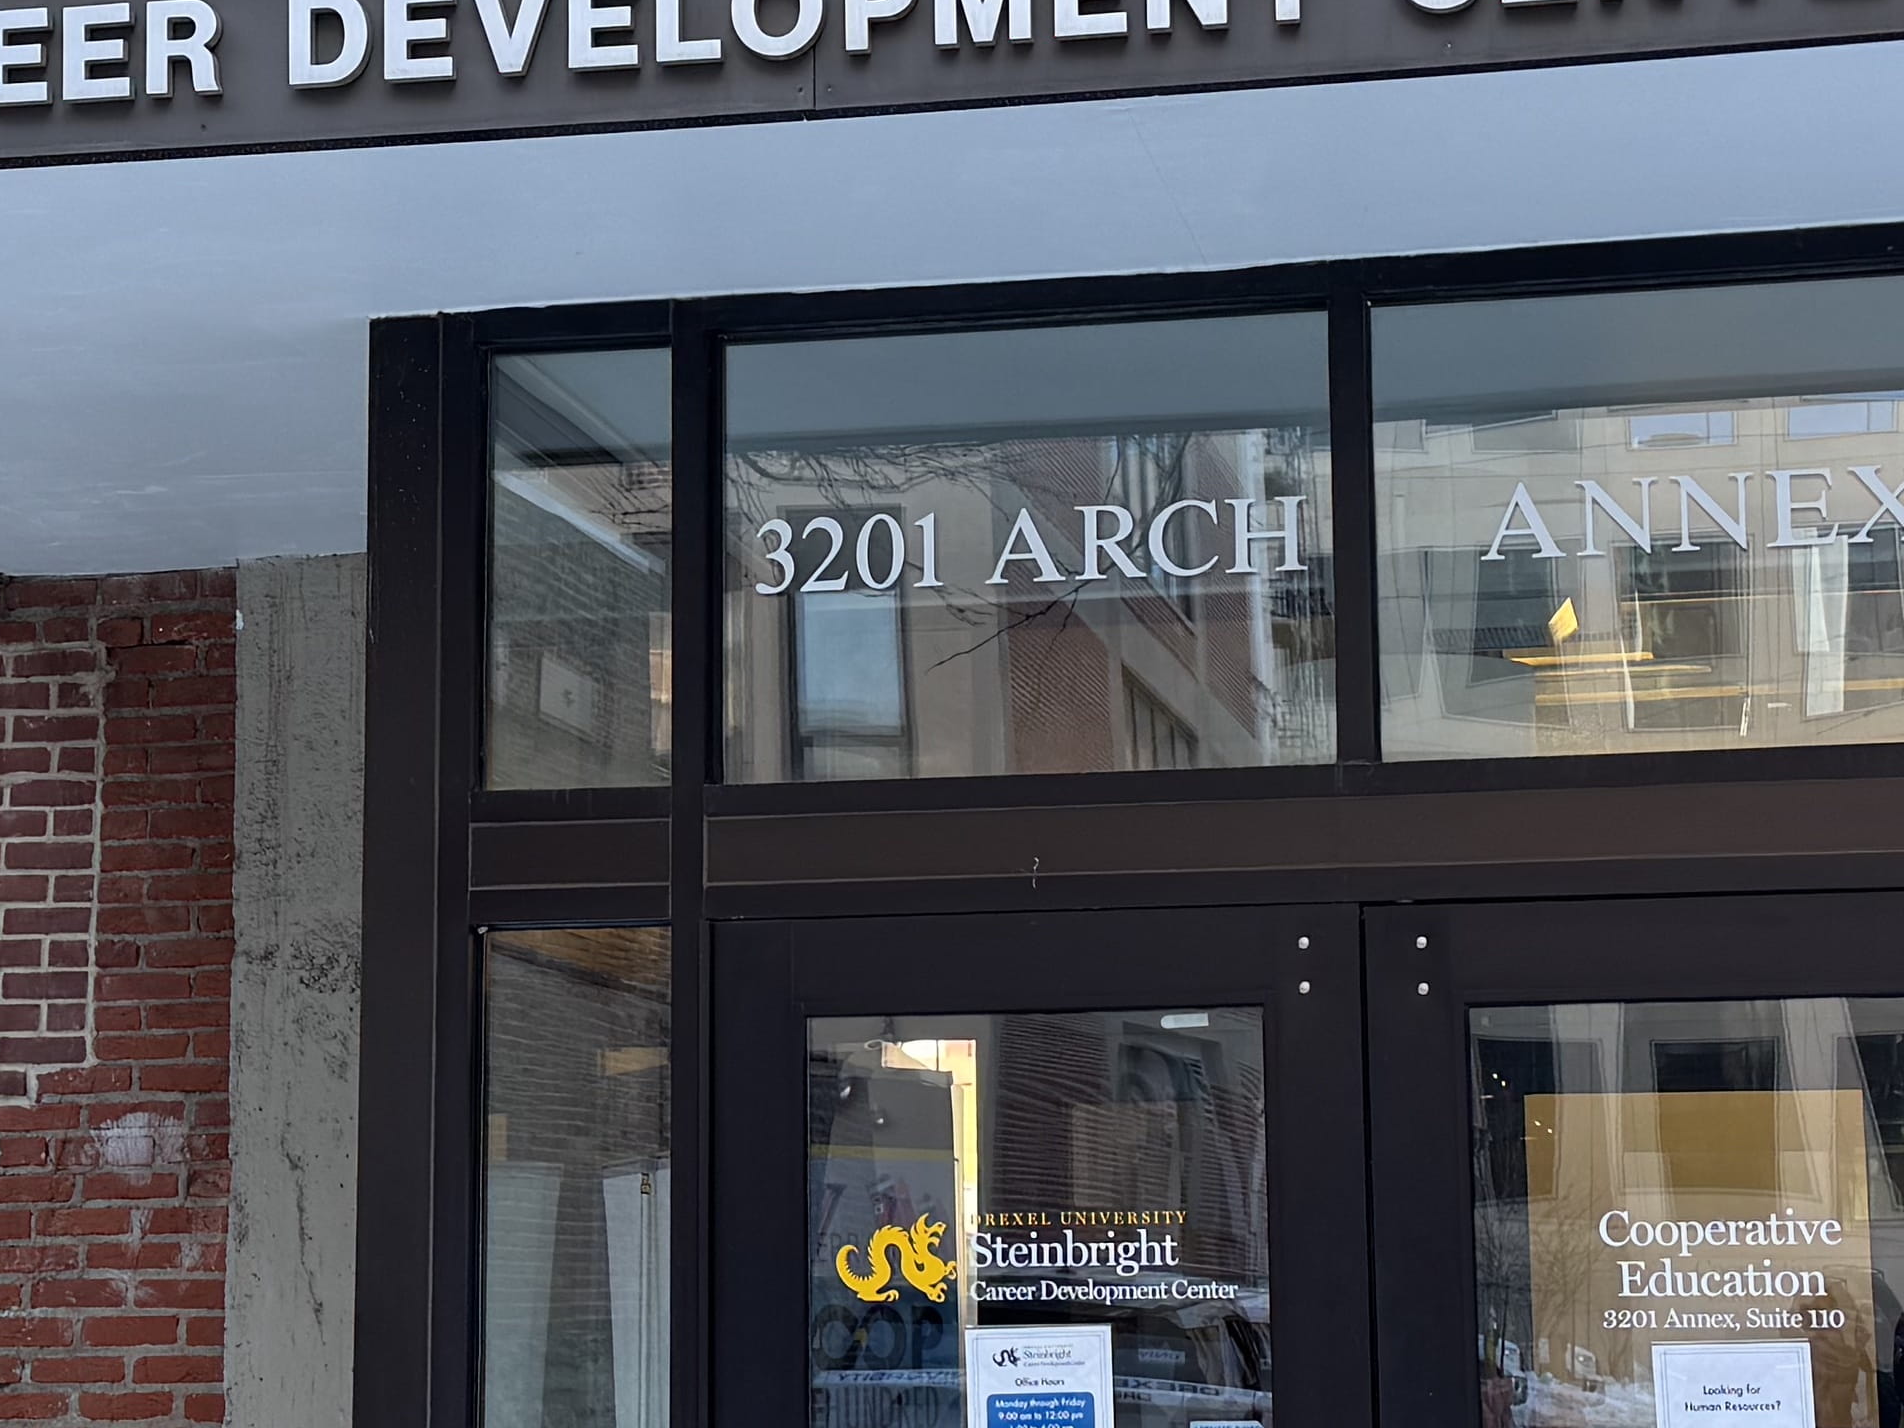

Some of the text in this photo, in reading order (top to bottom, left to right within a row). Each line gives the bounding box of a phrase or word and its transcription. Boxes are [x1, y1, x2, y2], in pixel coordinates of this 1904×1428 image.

[755, 495, 1308, 594] 3201 ARCH
[971, 1210, 1188, 1226] DREXEL UNIVERSITY
[1599, 1207, 1844, 1257] Cooperative
[970, 1229, 1179, 1276] Steinbright
[1616, 1257, 1828, 1298] Education
[970, 1278, 1239, 1305] Career Development Center
[1603, 1307, 1846, 1331] 3201 Annex, Suite 110
[1015, 1376, 1065, 1387] Office Hours
[1702, 1383, 1761, 1398] Looking for
[995, 1397, 1086, 1410] Monday through Friday
[1684, 1400, 1782, 1412] Human Resources?
[1019, 1413, 1032, 1421] am
[1033, 1411, 1042, 1420] to
[1045, 1410, 1070, 1420] 12:00
[1071, 1412, 1084, 1422] pm
